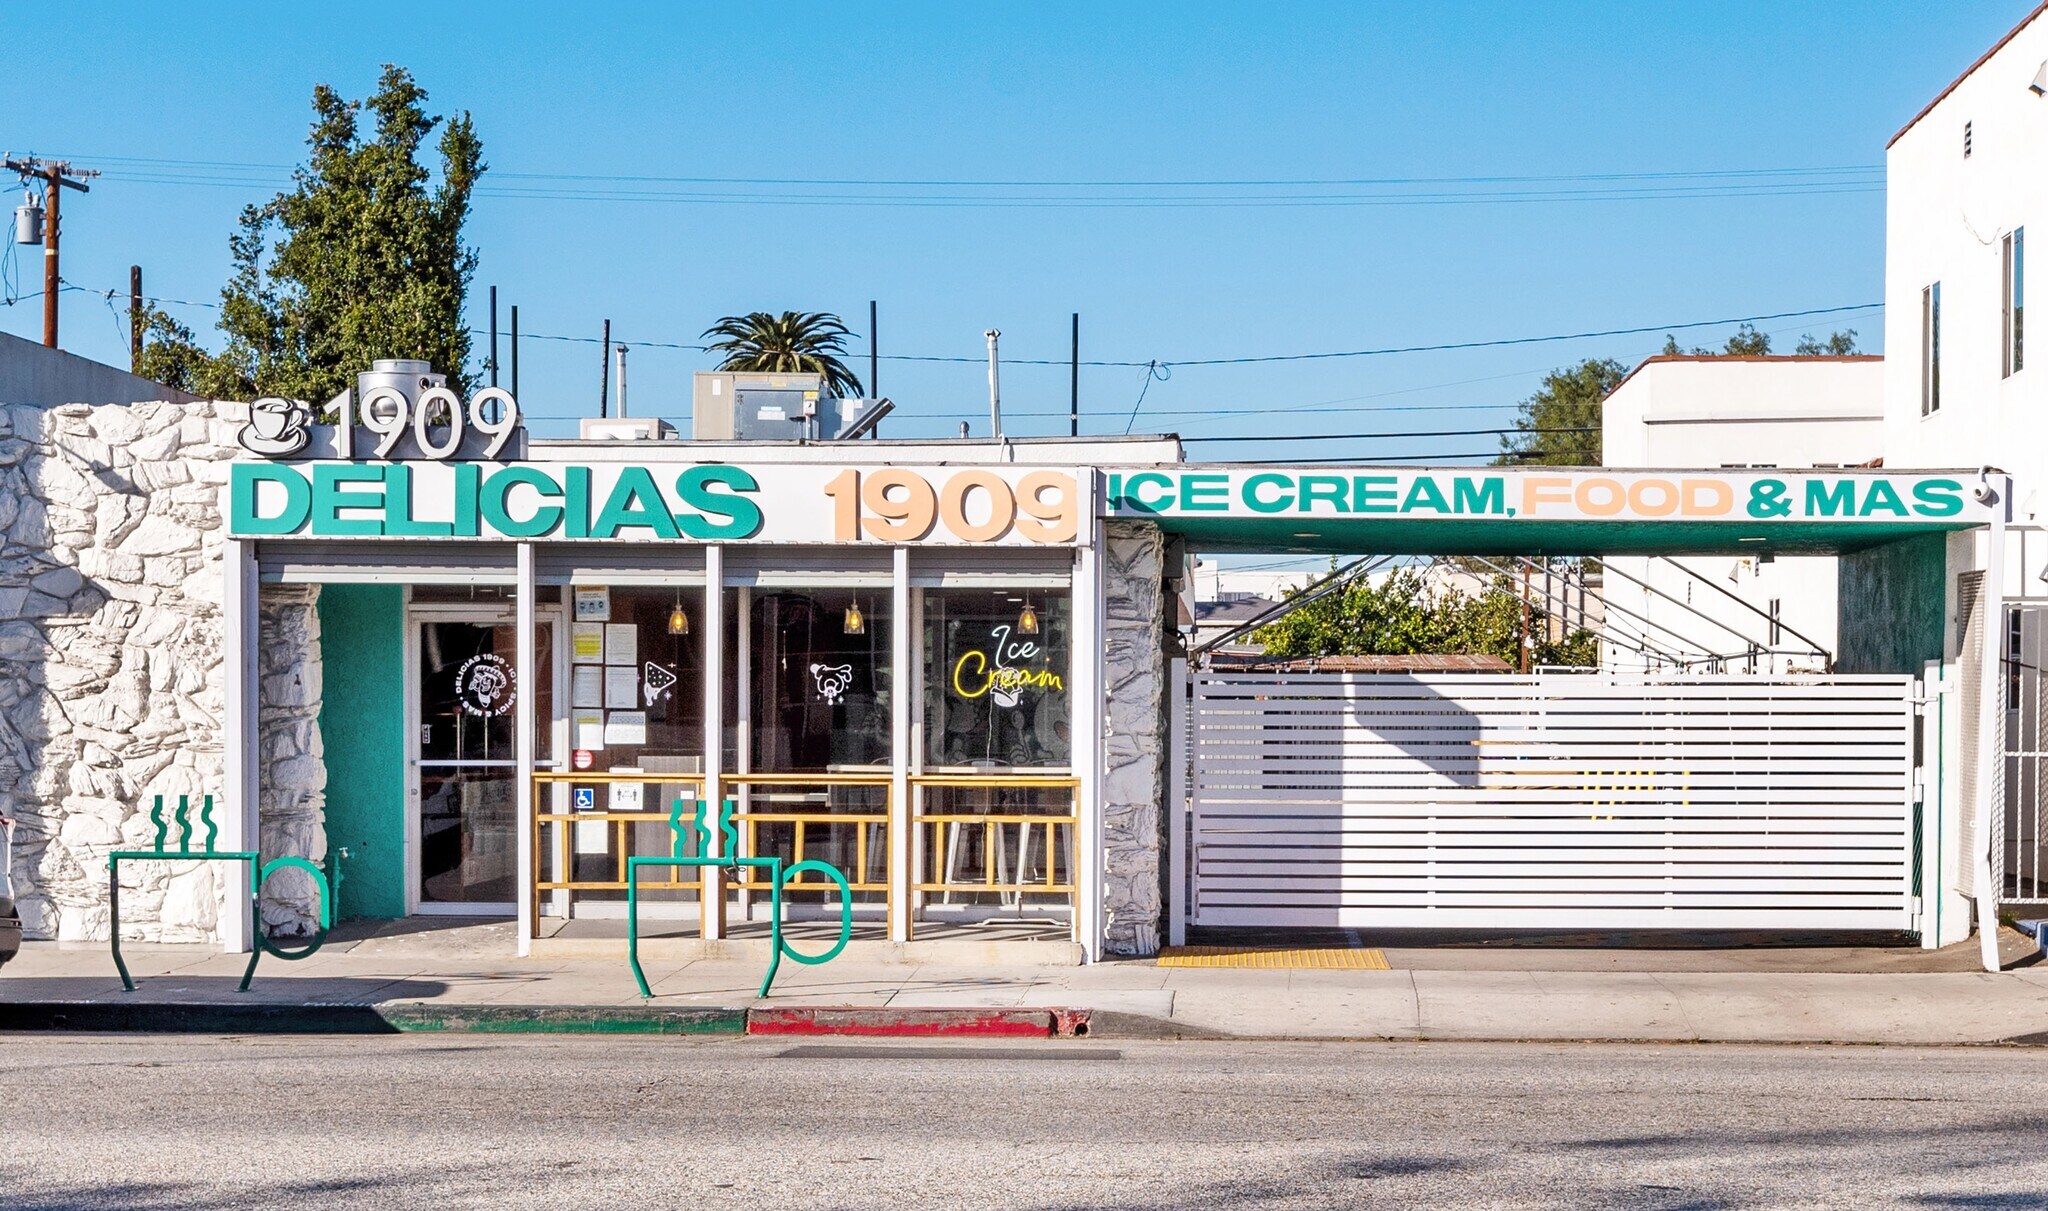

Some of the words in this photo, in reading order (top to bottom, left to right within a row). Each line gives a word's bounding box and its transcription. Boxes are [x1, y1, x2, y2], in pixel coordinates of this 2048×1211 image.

[323, 387, 520, 459] 1909
[231, 462, 763, 541] DELICIAS
[824, 468, 1077, 543] 1909
[1109, 473, 1229, 513] ICE
[1242, 473, 1516, 518] CREAM,
[1522, 478, 1734, 516] FOOD
[1746, 479, 1793, 518] &
[1805, 479, 1964, 517] MAS
[482, 653, 505, 665] 1909
[991, 625, 1040, 668] Ice
[455, 654, 481, 694] DELICIAS
[954, 650, 1063, 698] Cream
[462, 700, 483, 717] MAS
[494, 692, 517, 717] SPICY
